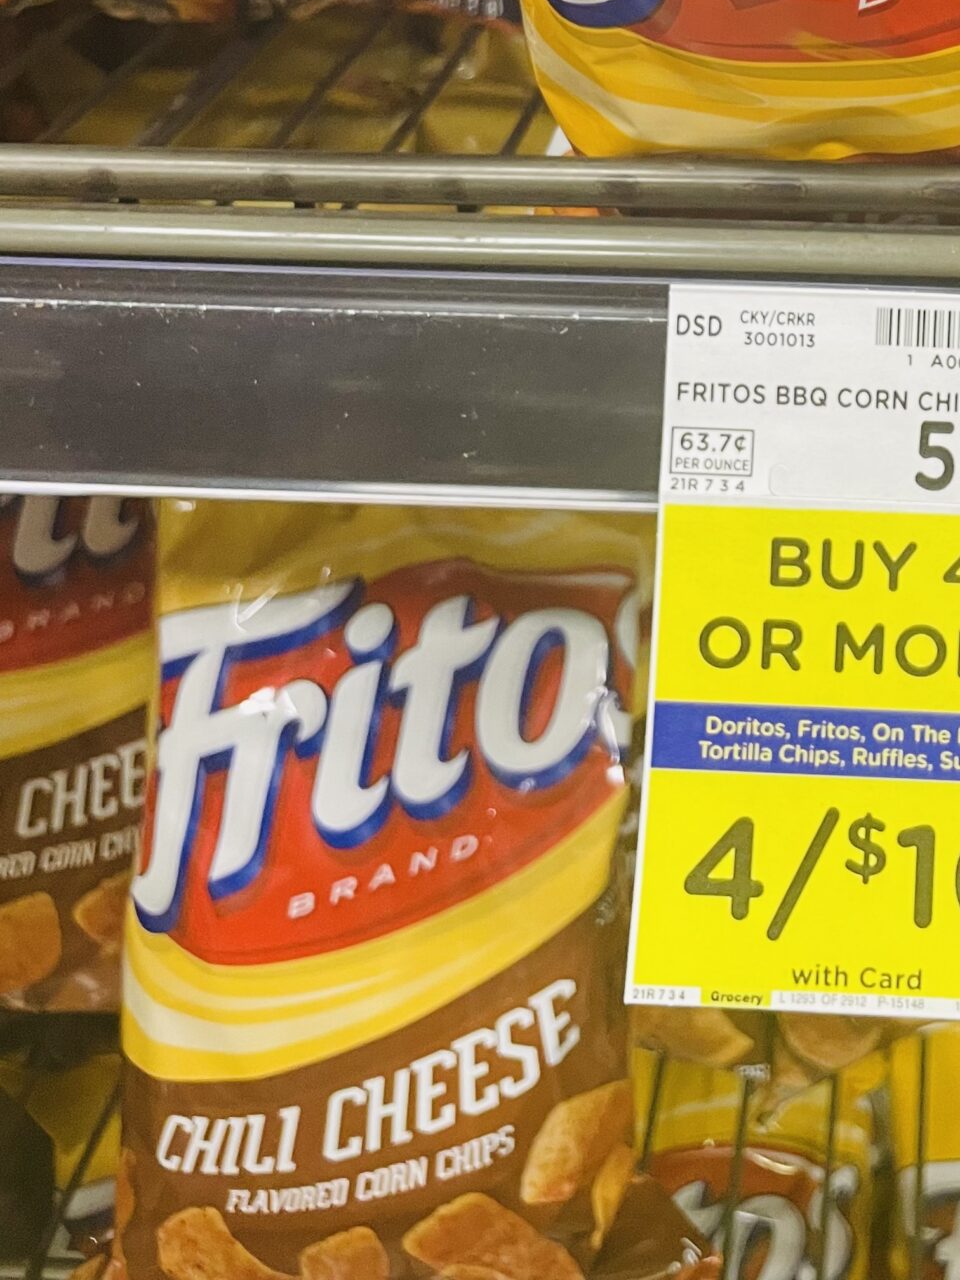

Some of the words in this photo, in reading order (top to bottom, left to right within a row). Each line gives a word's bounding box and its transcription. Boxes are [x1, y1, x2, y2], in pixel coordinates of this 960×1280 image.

[676, 314, 722, 337] DSD
[740, 310, 816, 327] CKY/CRKR
[743, 331, 816, 348] 3001013
[677, 381, 766, 405] FRITOS
[776, 385, 827, 407] BBQ
[837, 388, 908, 411] CORN
[680, 432, 746, 452] 63.7¢
[675, 457, 700, 469] PER
[704, 458, 749, 472] OUNCE
[769, 536, 917, 592] BUY
[698, 615, 801, 672] OR
[705, 715, 791, 741] Doritos,
[798, 719, 866, 744] Fritos,
[872, 722, 904, 742] On
[912, 723, 951, 745] The
[699, 740, 773, 763] Tortilla
[778, 743, 846, 767] Chips,
[852, 747, 934, 773] Ruffles,
[287, 833, 479, 919] BRAND
[791, 965, 848, 987] with
[860, 968, 922, 990] Card
[710, 990, 764, 1006] Grocery
[156, 1104, 298, 1175] CHILI
[322, 977, 581, 1163] CHEESE
[226, 1177, 350, 1215] FLAVORED
[355, 1156, 428, 1197] CORN
[435, 1125, 515, 1181] CHIPS
